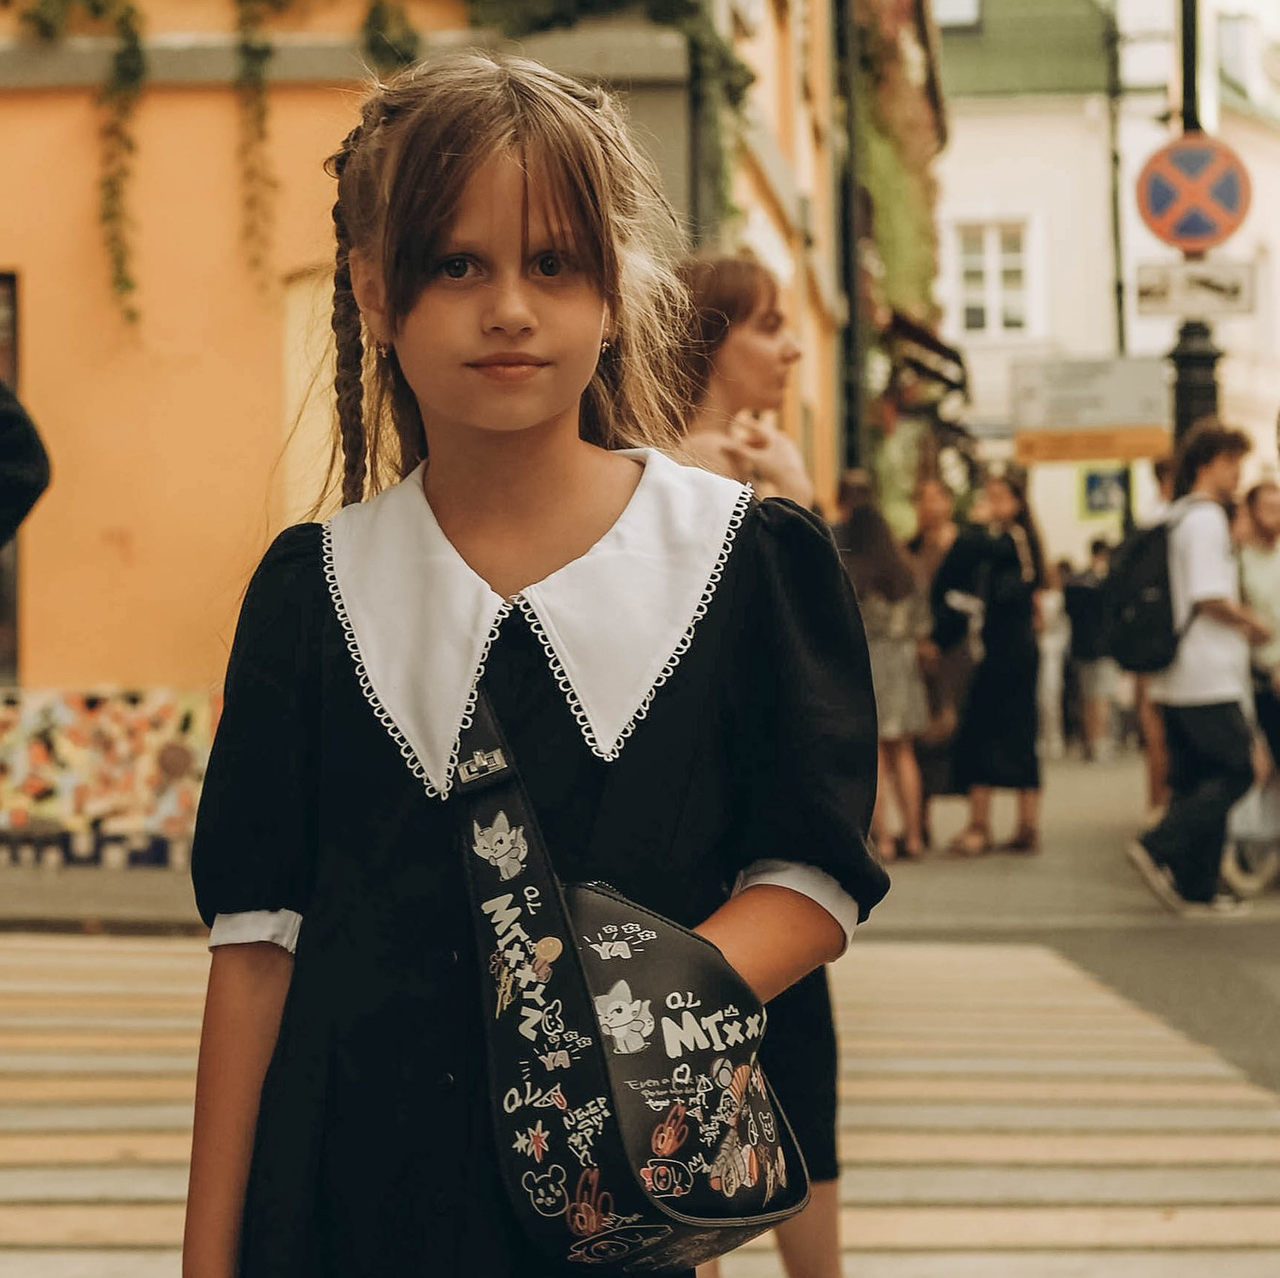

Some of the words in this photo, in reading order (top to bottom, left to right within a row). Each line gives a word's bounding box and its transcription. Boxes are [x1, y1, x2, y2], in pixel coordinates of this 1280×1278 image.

[589, 940, 632, 960] YA
[665, 991, 701, 1009] QL
[538, 1049, 571, 1071] YA
